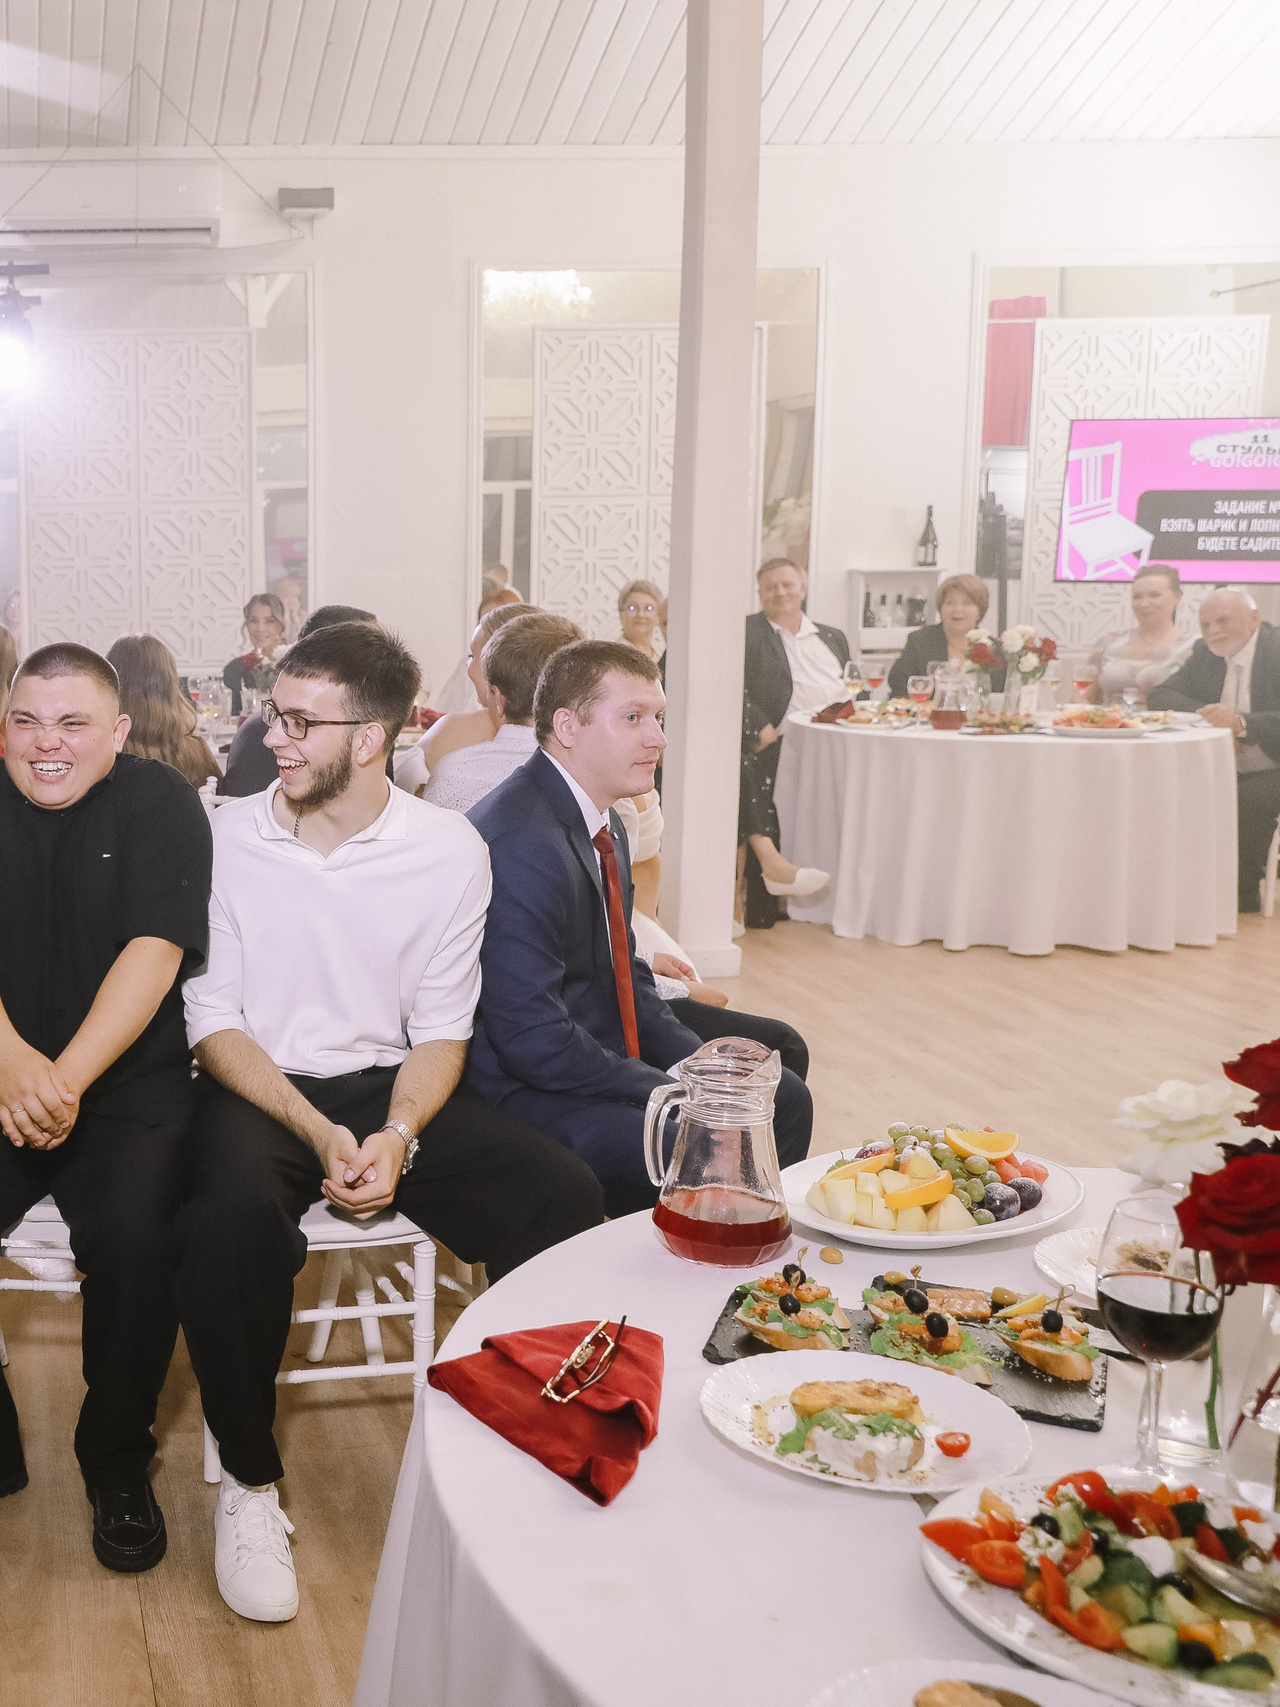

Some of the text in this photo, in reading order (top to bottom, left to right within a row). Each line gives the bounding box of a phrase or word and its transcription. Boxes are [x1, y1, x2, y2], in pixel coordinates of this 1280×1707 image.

[1251, 434, 1270, 444] 11
[1216, 444, 1280, 456] СТУЛЬ
[1213, 500, 1268, 516] ЗАДАНИЕ
[1160, 518, 1196, 533] ВЗЯТЬ
[1196, 518, 1238, 533] ШАРИК
[1238, 518, 1249, 533] И
[1196, 536, 1239, 553] БУДЕТЕ
